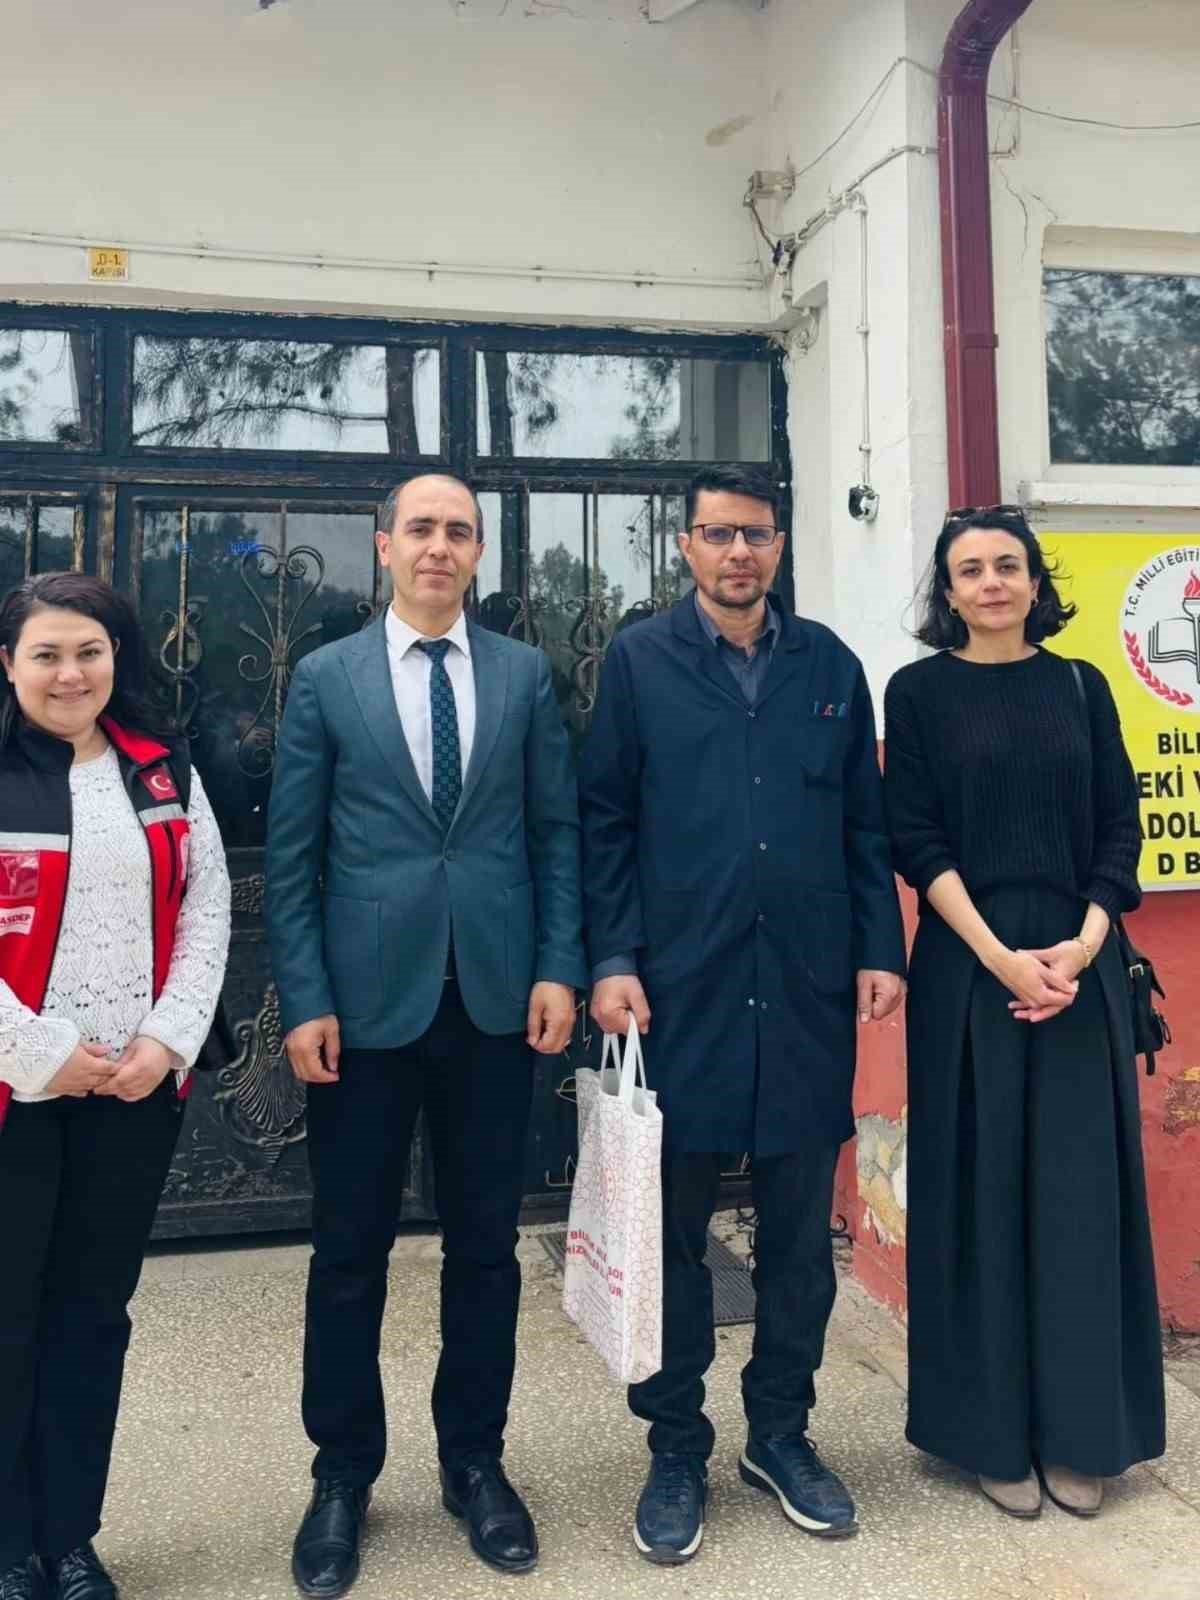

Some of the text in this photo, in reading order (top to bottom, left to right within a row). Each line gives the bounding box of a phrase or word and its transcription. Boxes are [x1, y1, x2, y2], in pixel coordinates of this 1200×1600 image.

[1125, 594, 1141, 616] T.C.
[1136, 557, 1165, 591] MİLLİ
[1158, 728, 1200, 755] BİL
